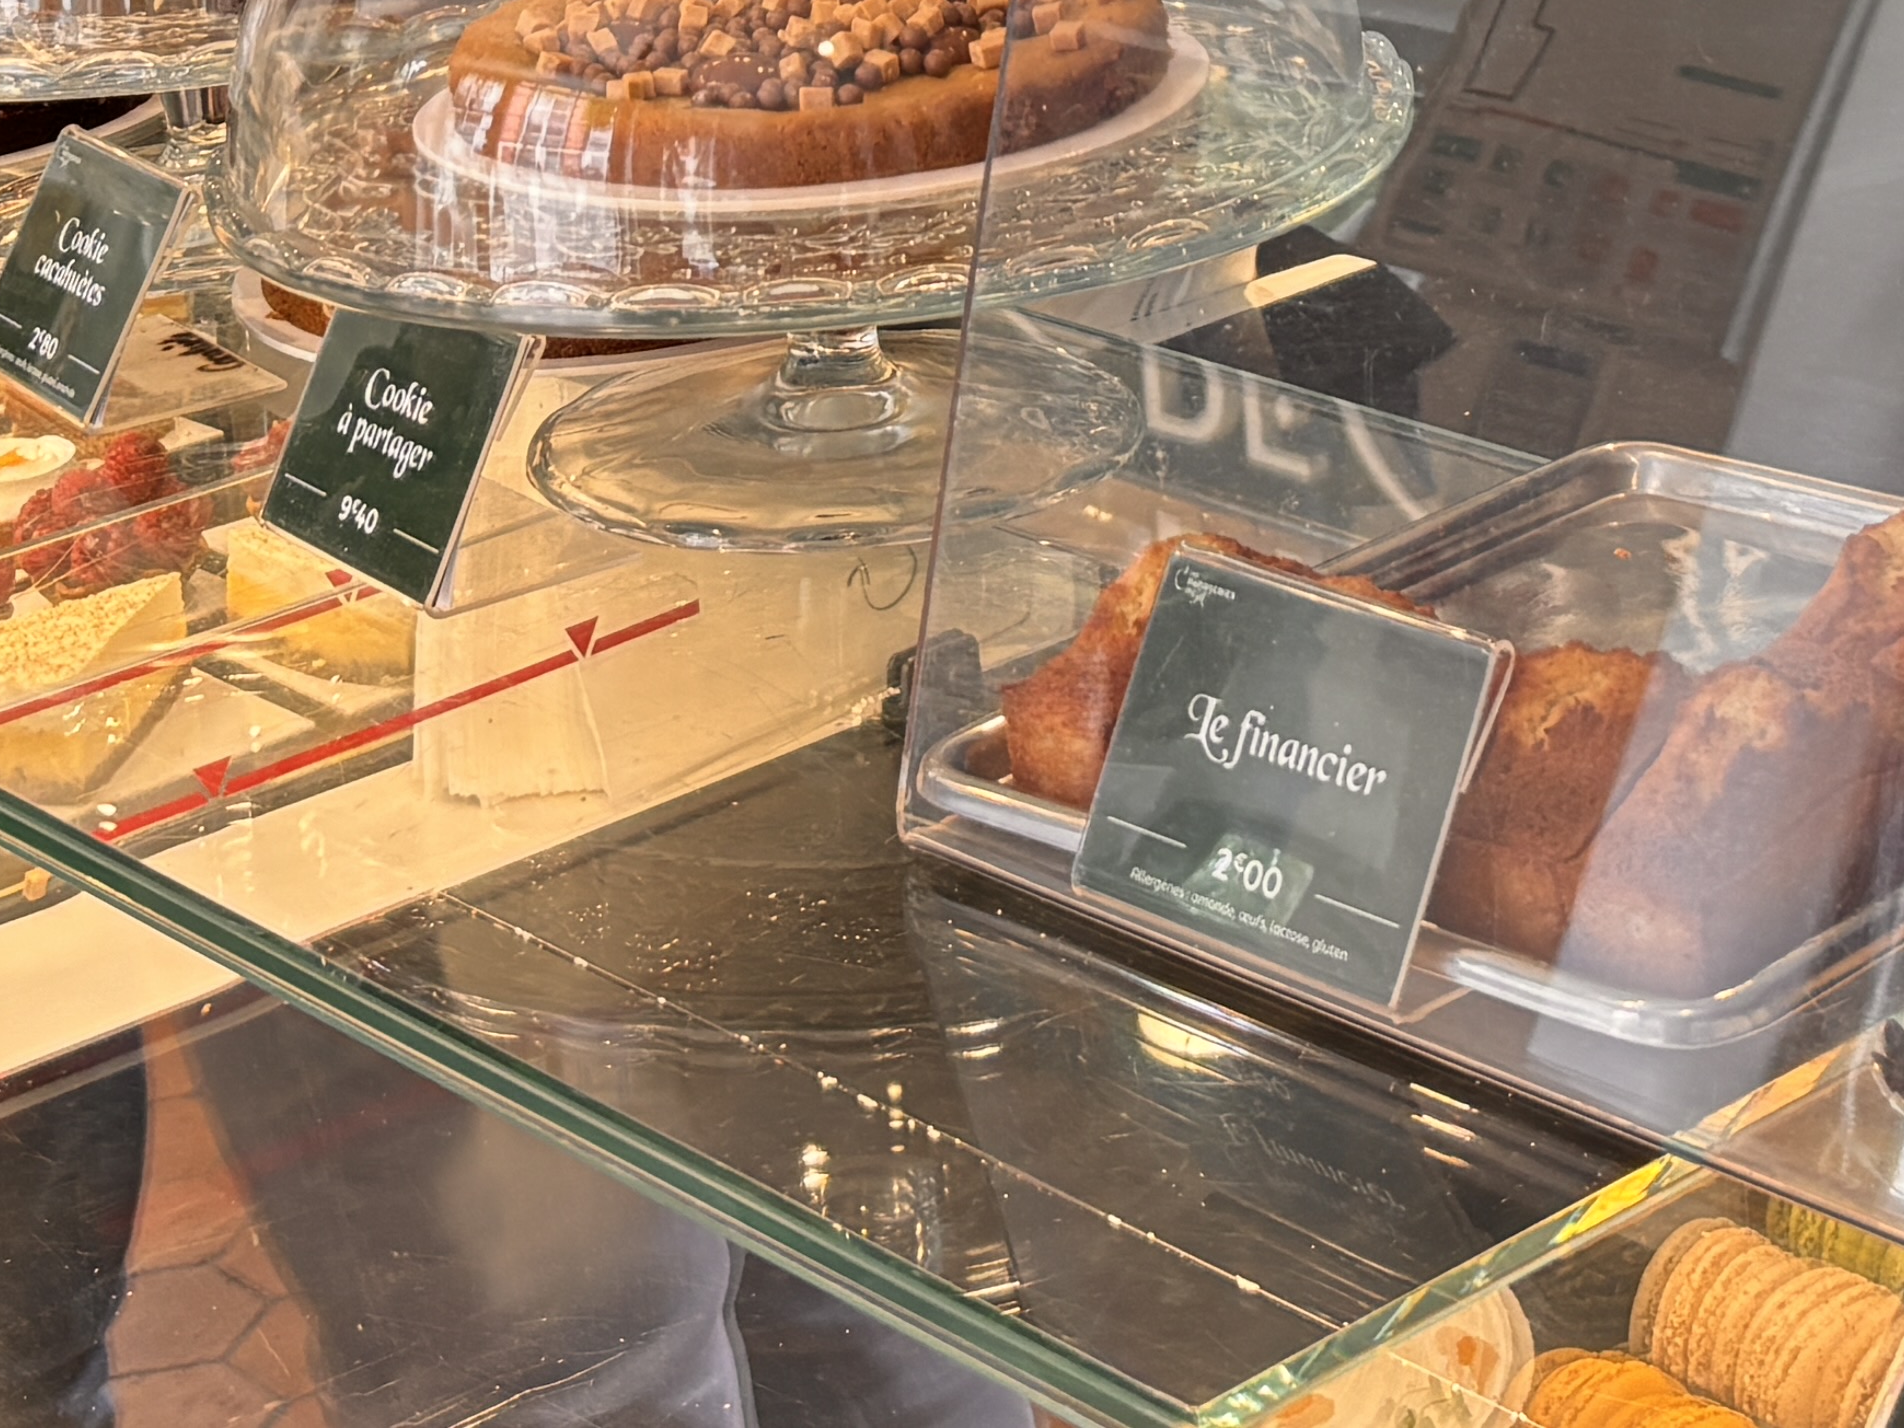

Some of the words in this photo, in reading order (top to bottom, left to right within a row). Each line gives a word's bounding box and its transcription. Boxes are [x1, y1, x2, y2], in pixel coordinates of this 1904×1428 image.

[58, 216, 110, 265] Cookie
[33, 253, 107, 307] cacahuètes
[364, 367, 435, 425] Cookie
[336, 402, 354, 435] à
[346, 416, 434, 480] partager
[1183, 692, 1230, 764] Le
[1220, 709, 1388, 797] financier
[1211, 847, 1284, 900] 2€00
